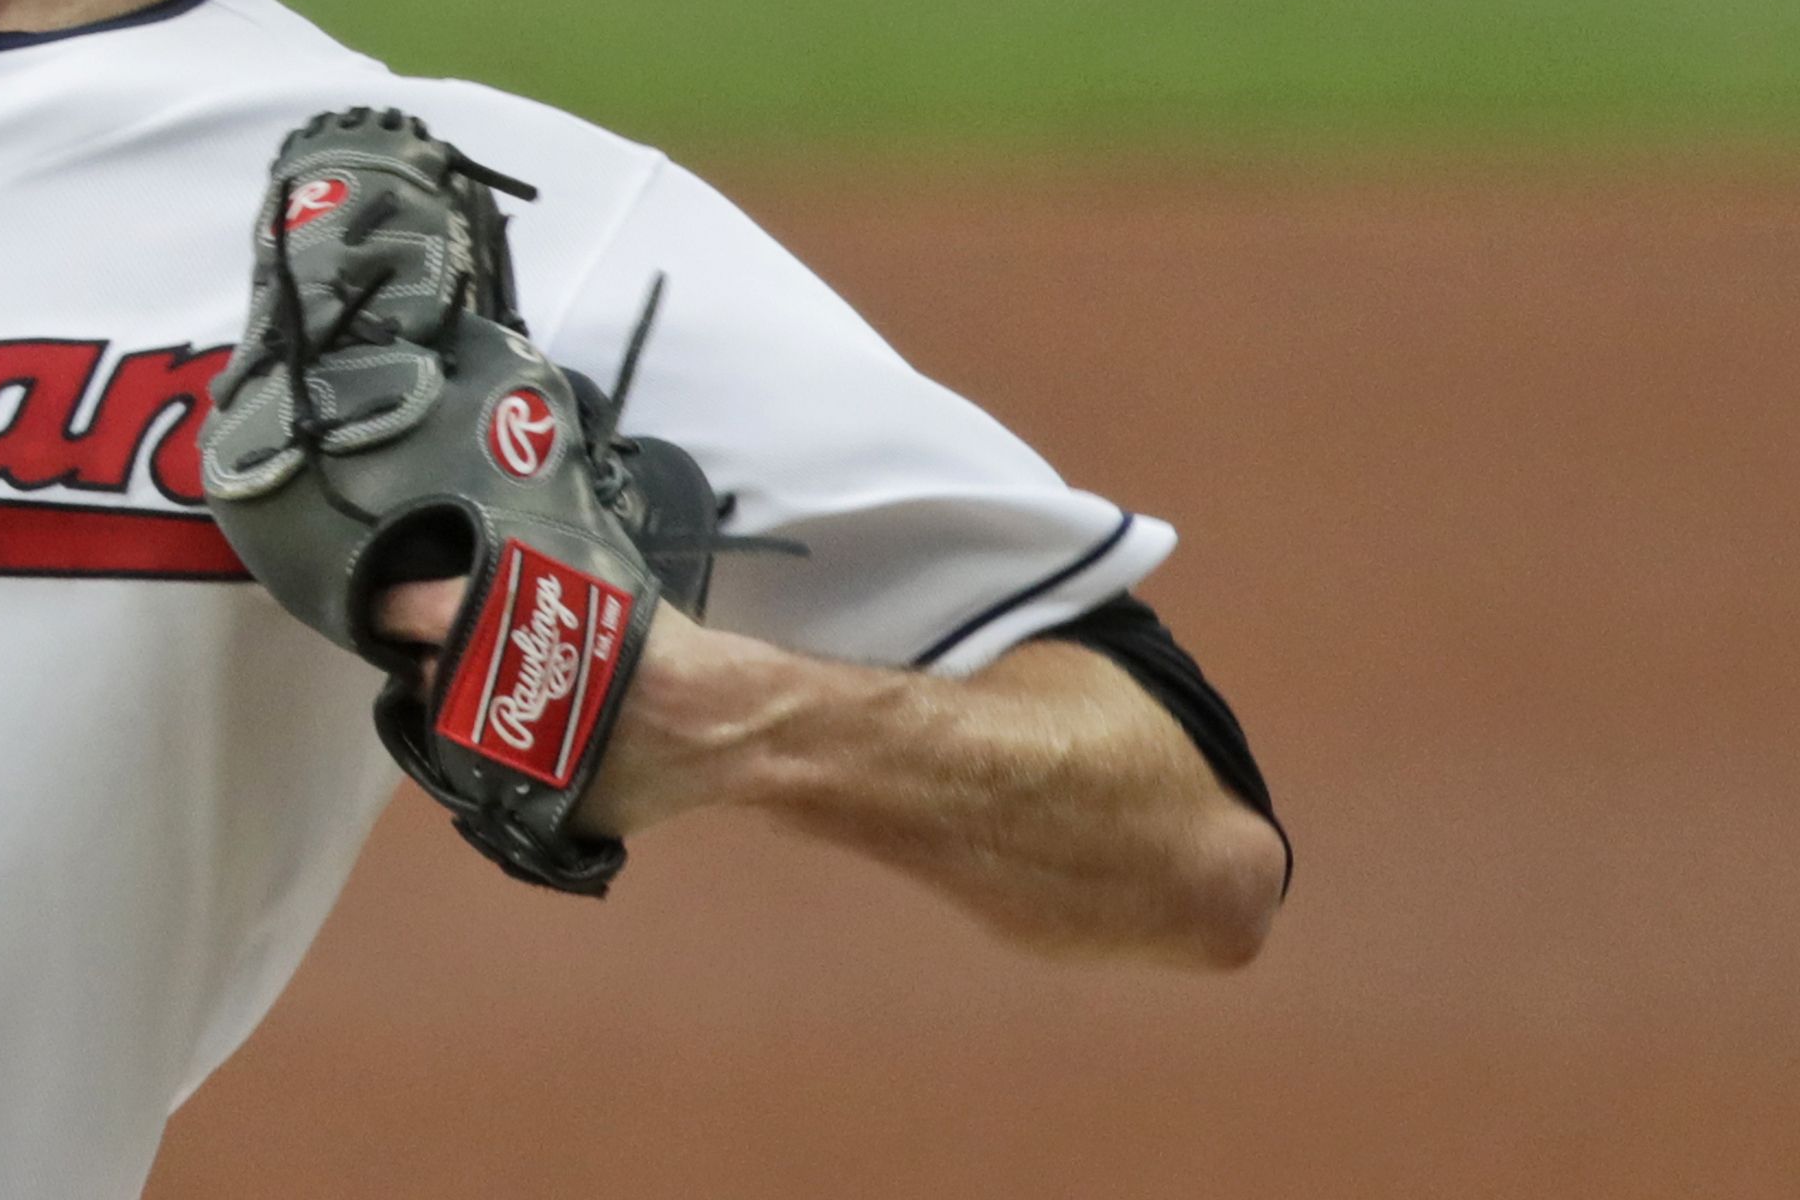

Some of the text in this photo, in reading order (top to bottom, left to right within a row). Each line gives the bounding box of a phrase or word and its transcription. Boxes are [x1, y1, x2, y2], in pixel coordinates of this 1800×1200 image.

[286, 180, 335, 221] R
[496, 395, 555, 475] R
[489, 573, 579, 751] Rawlings
